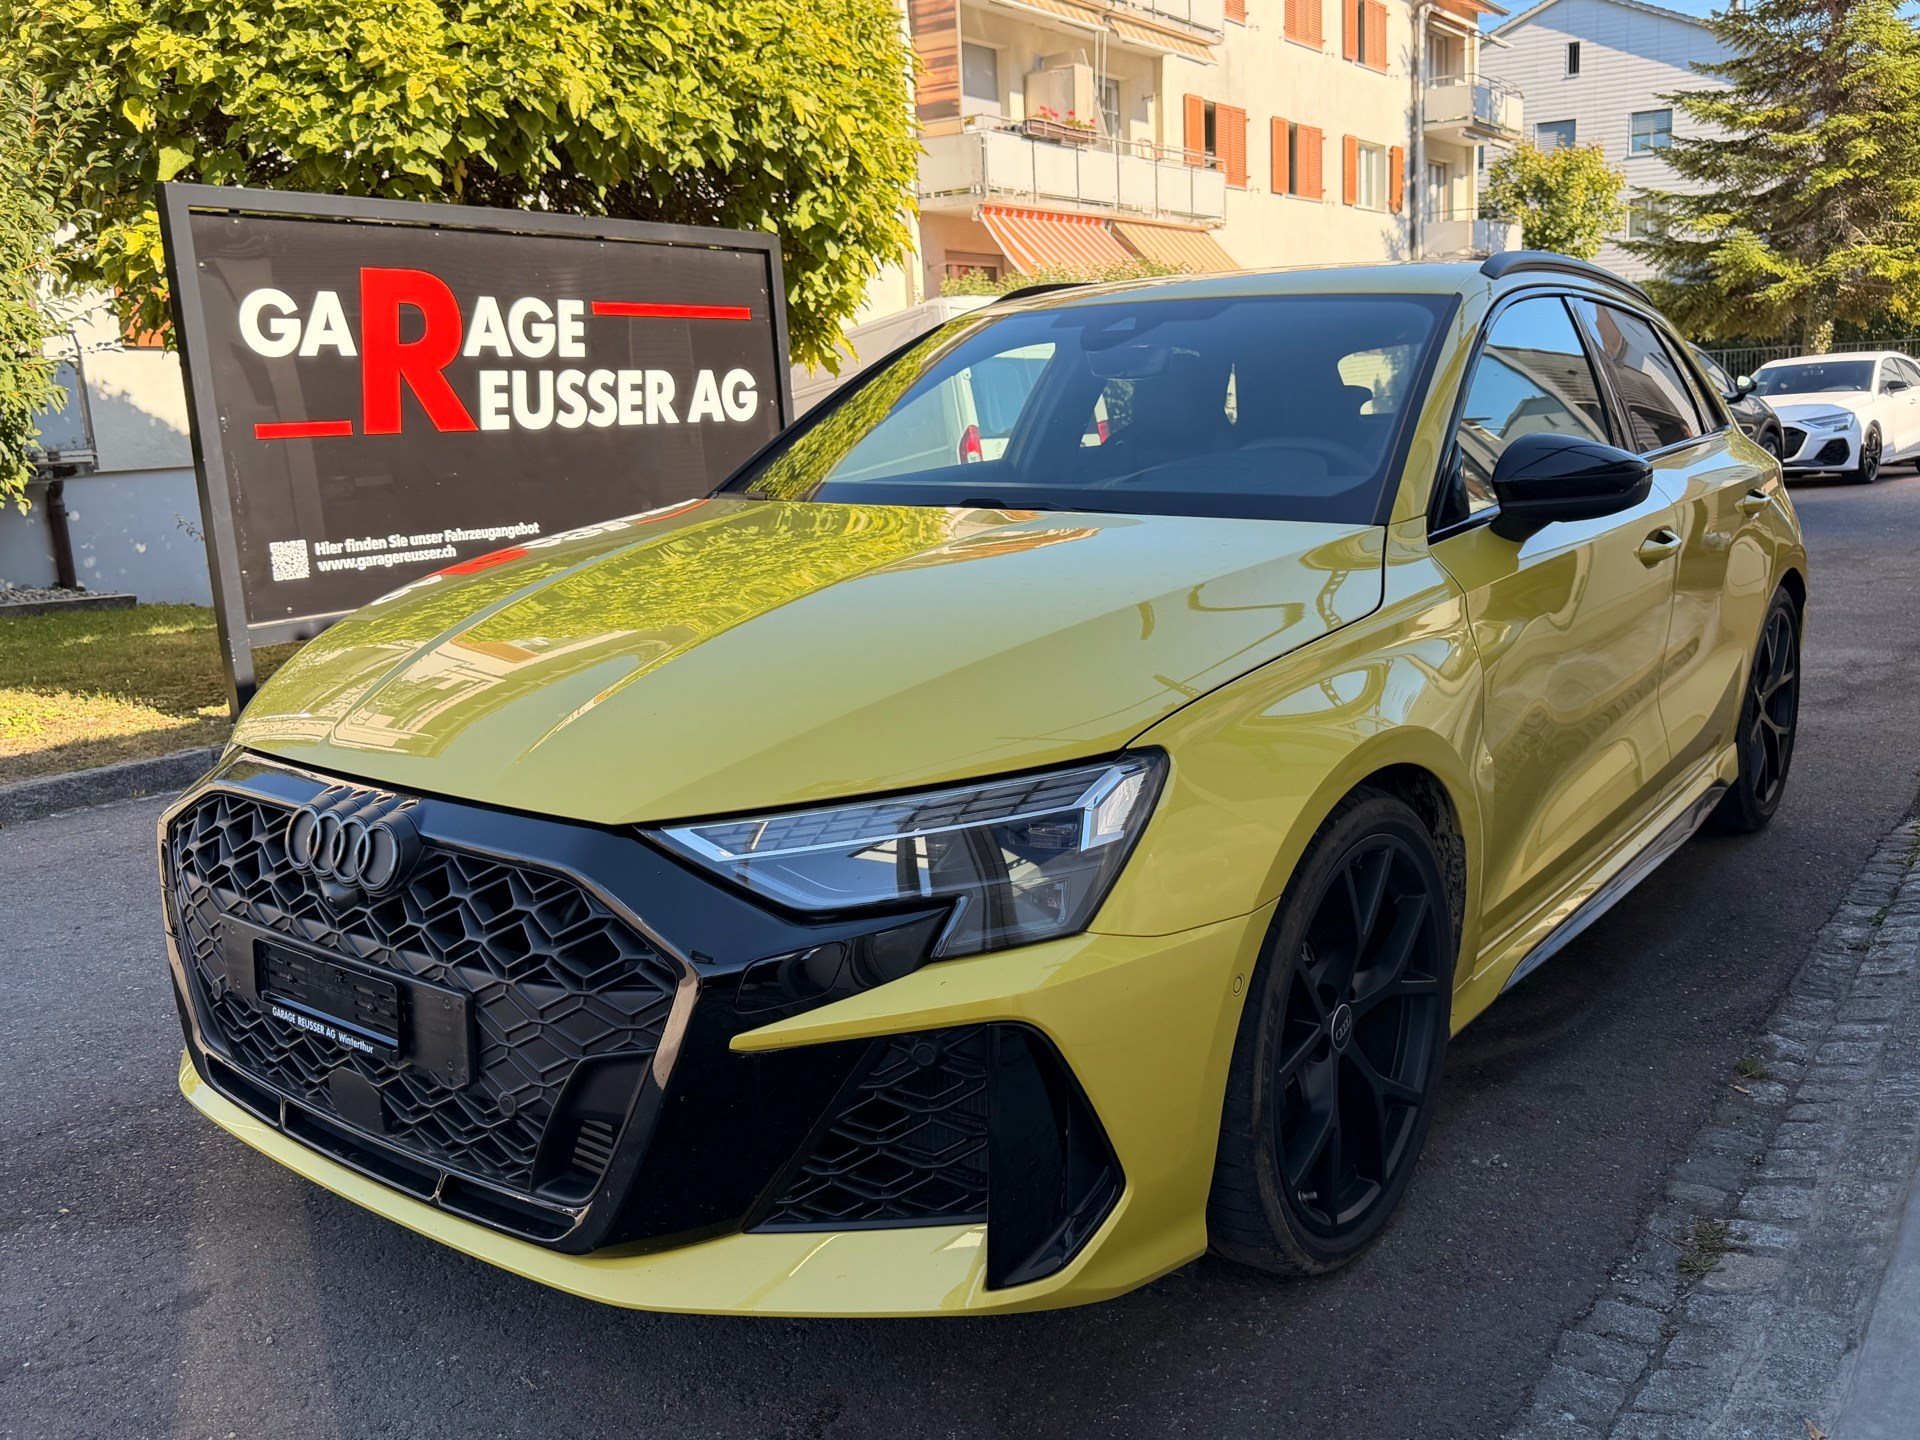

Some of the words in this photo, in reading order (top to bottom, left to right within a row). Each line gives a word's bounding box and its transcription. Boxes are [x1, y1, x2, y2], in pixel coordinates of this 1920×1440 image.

[238, 266, 586, 435] GARAGE
[687, 367, 758, 424] AG
[315, 541, 343, 556] Hier
[344, 536, 387, 553] finden
[388, 533, 409, 549] Sie
[409, 531, 443, 547] unser
[444, 522, 541, 543] Fahrzeugangebot
[317, 544, 457, 572] www.garagereusser.ch
[272, 1006, 296, 1024] GARAGE
[297, 1016, 325, 1035] REUSSER
[325, 1027, 336, 1039] AG
[338, 1032, 374, 1054] Winterthur
